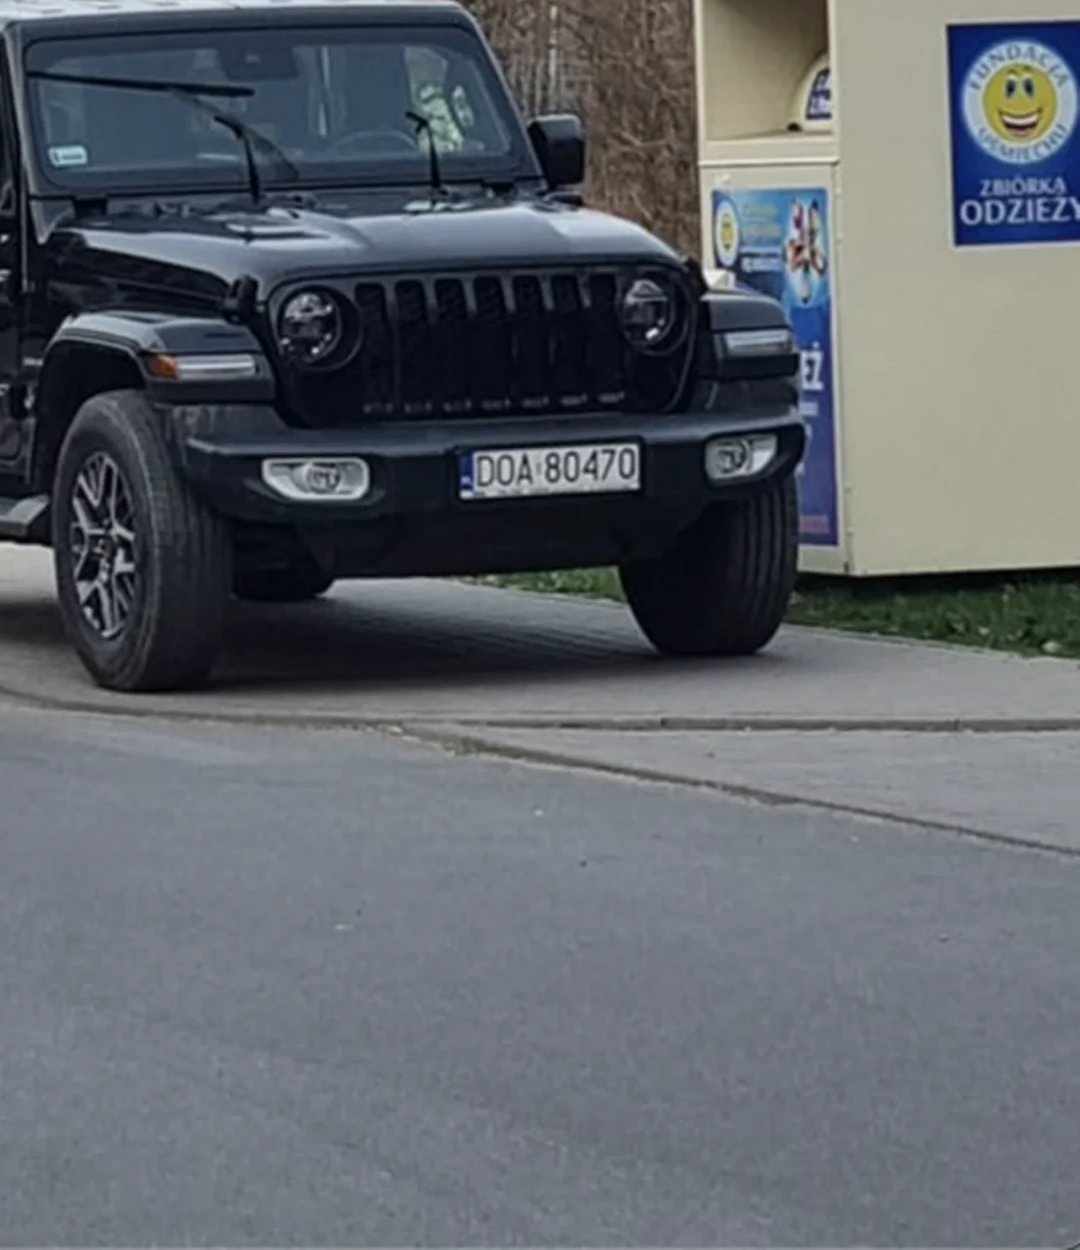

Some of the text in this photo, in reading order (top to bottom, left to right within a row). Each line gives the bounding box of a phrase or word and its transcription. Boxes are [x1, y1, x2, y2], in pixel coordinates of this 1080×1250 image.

[970, 44, 1069, 90] FUNDACJA
[980, 175, 1067, 197] ZBIÓRKA
[476, 447, 637, 488] DOA 80470
